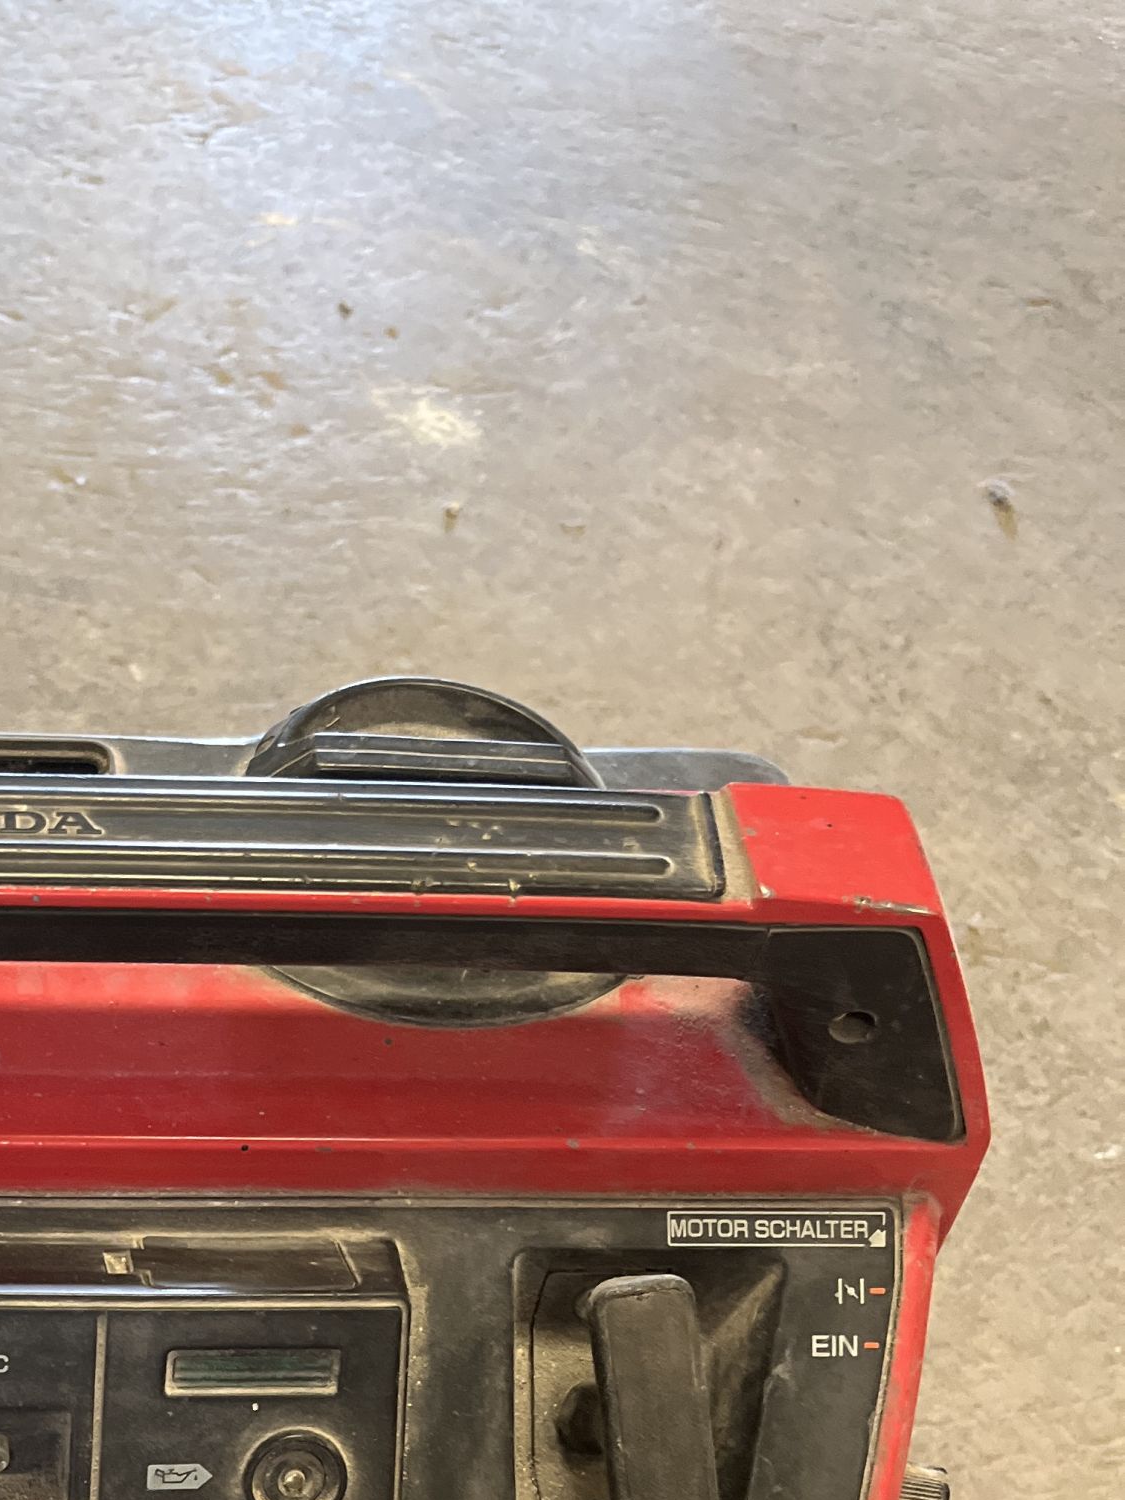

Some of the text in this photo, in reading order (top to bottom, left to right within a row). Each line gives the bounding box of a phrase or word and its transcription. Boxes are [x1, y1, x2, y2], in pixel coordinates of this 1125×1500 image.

[670, 1218, 869, 1239] MOTOR SCHALTER
[811, 1334, 859, 1357] EIN
